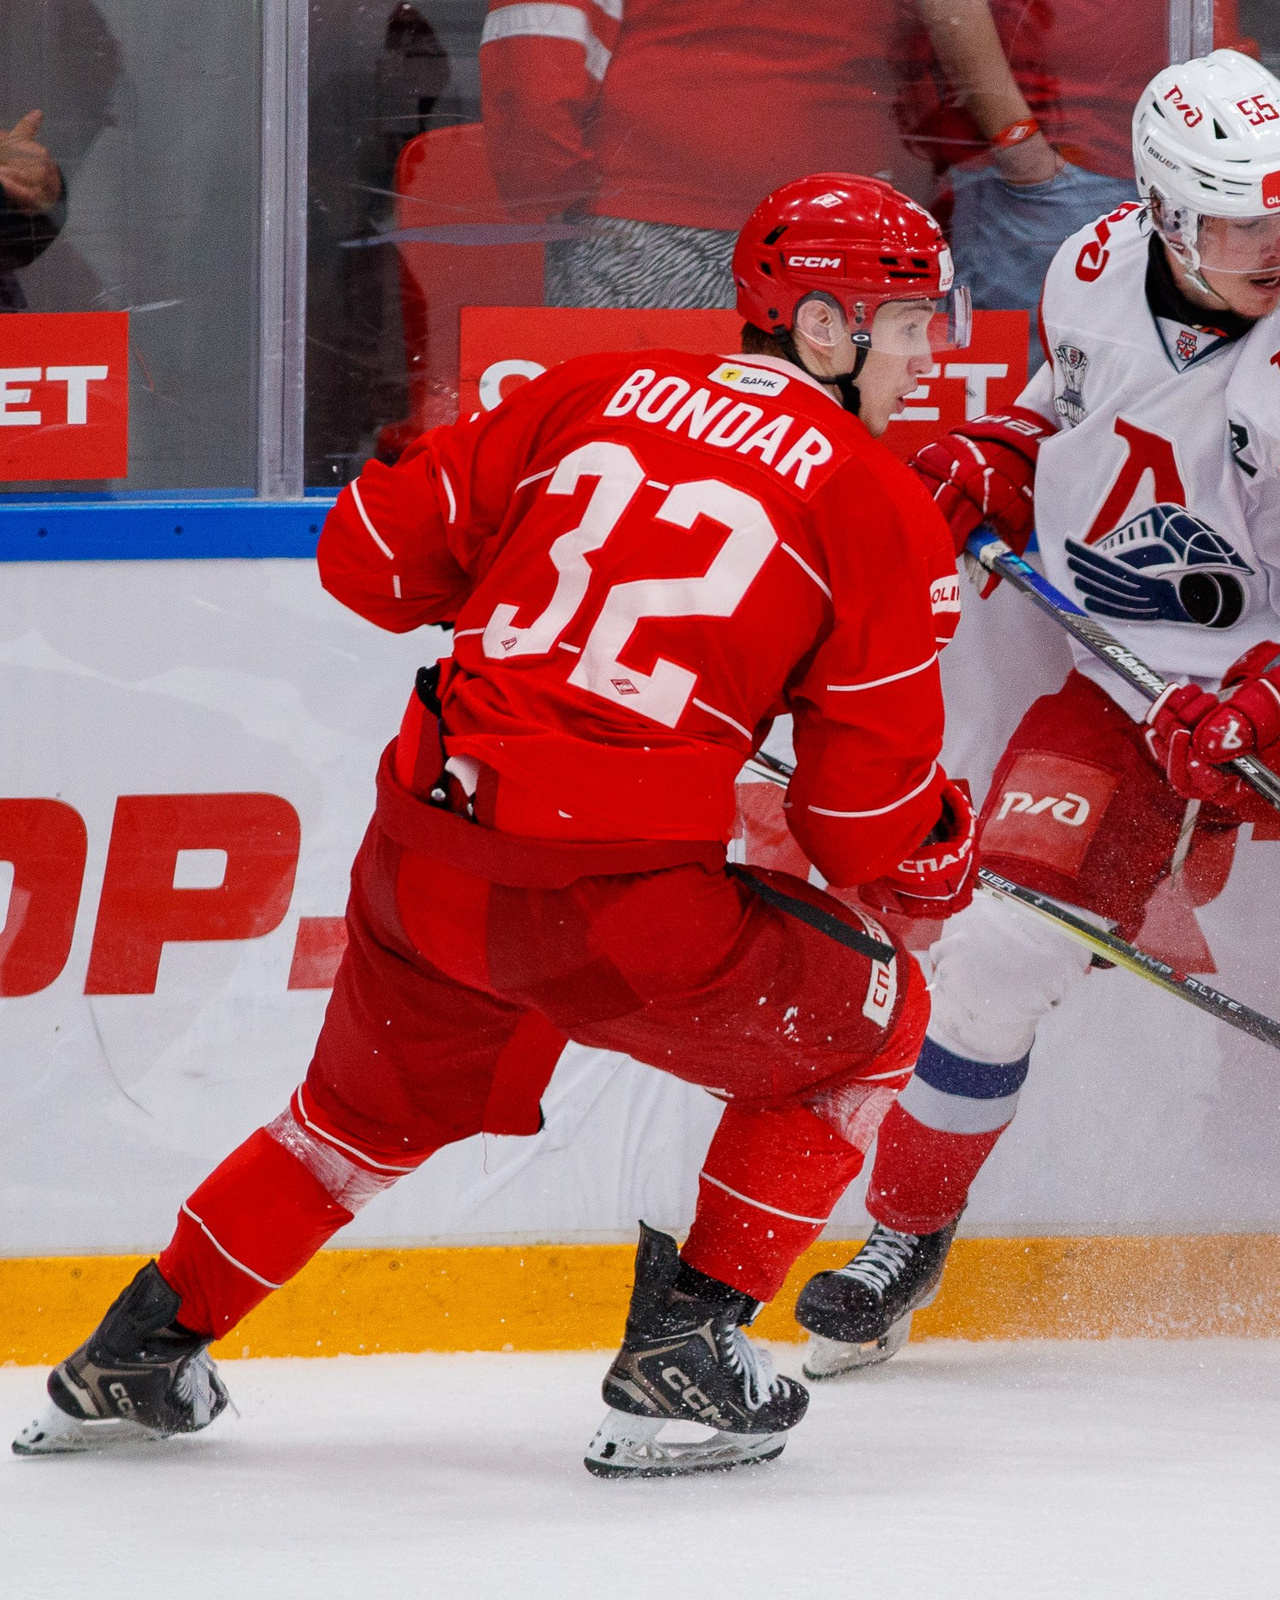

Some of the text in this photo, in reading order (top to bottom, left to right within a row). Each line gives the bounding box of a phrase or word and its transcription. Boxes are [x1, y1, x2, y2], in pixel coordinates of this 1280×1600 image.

[1236, 94, 1280, 126] 95
[788, 256, 841, 269] CCM
[740, 376, 778, 389] БАНК
[602, 368, 833, 491] BONDAR
[482, 440, 781, 728] 32
